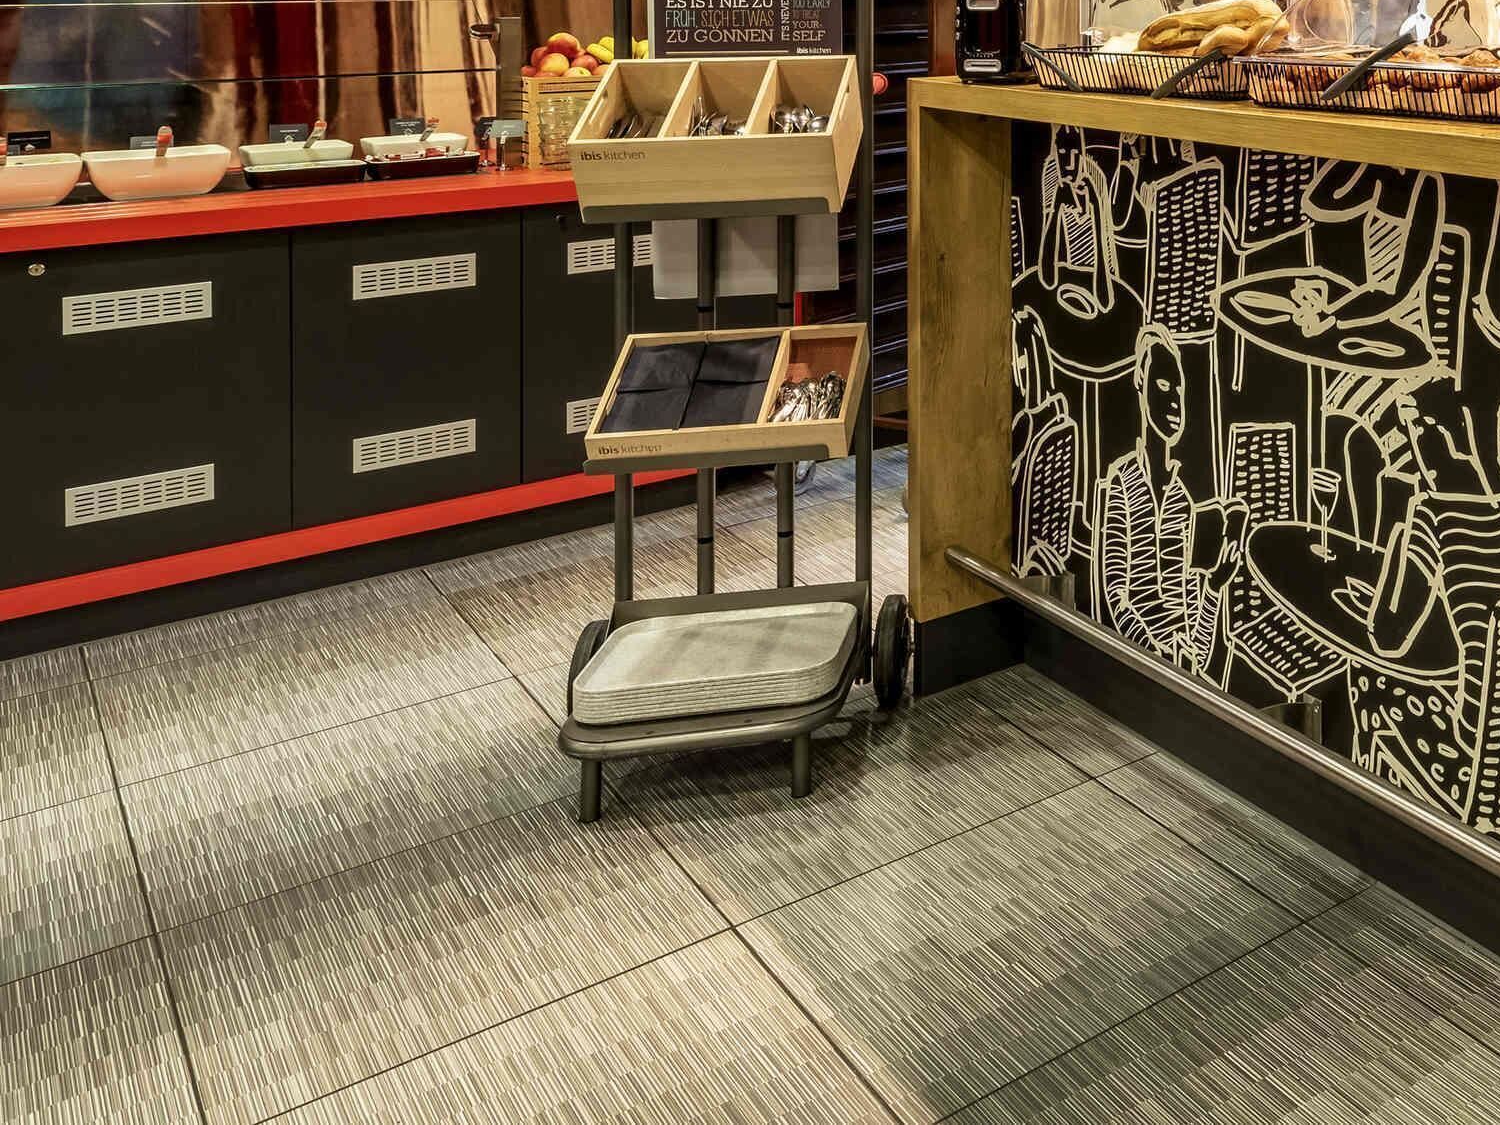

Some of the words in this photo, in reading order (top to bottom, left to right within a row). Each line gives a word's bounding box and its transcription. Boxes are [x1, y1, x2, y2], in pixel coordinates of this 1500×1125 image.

[700, 9, 729, 27] SICH
[731, 9, 775, 27] ETWAS
[792, 20, 822, 30] YOUR-
[666, 29, 689, 43] ZU
[694, 26, 774, 43] GÖNNEN
[792, 30, 826, 42] SELF
[796, 46, 808, 54] ibis
[580, 150, 602, 161] ibis
[603, 150, 646, 161] kitchen
[598, 444, 620, 455] ibis
[620, 442, 662, 454] kitchen
